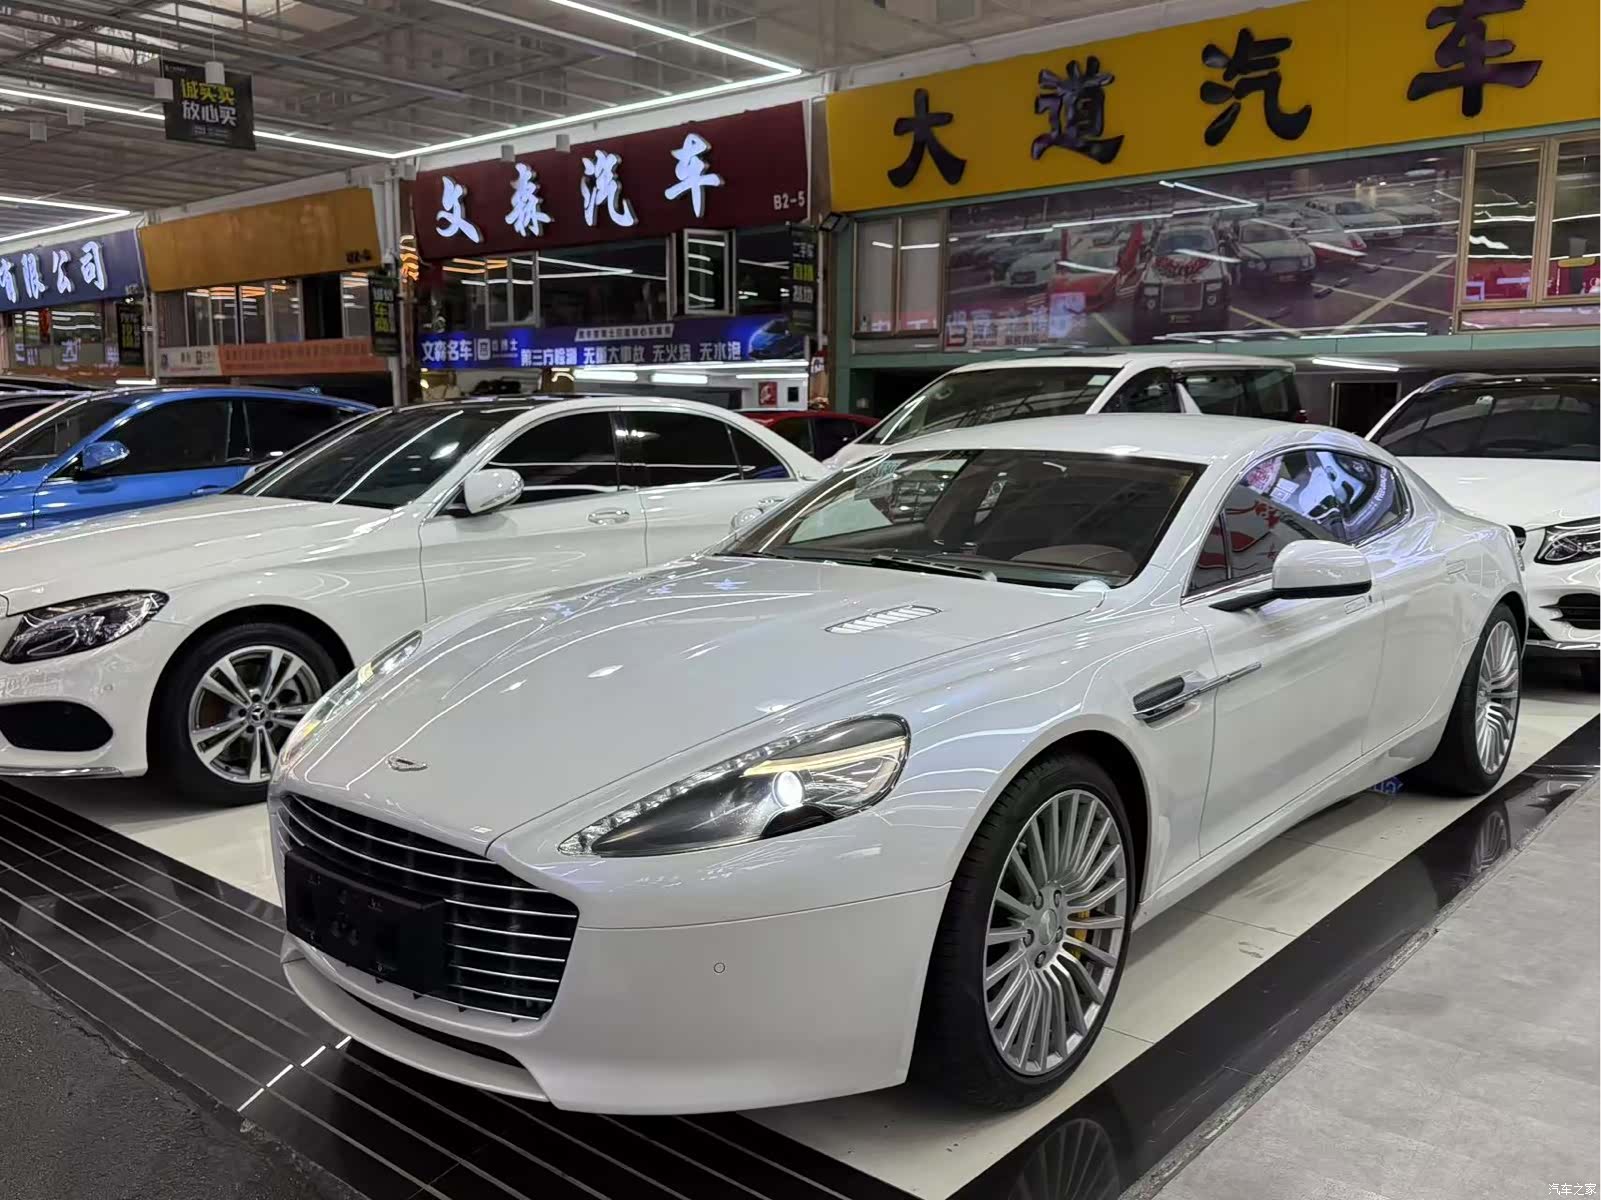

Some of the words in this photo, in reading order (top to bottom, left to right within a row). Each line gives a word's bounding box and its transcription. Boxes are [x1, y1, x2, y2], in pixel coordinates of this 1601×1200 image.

[182, 100, 237, 127] 放心买
[887, 0, 1542, 187] 大道汽车
[436, 133, 726, 244] 文森汽车
[773, 191, 806, 211] B2-5
